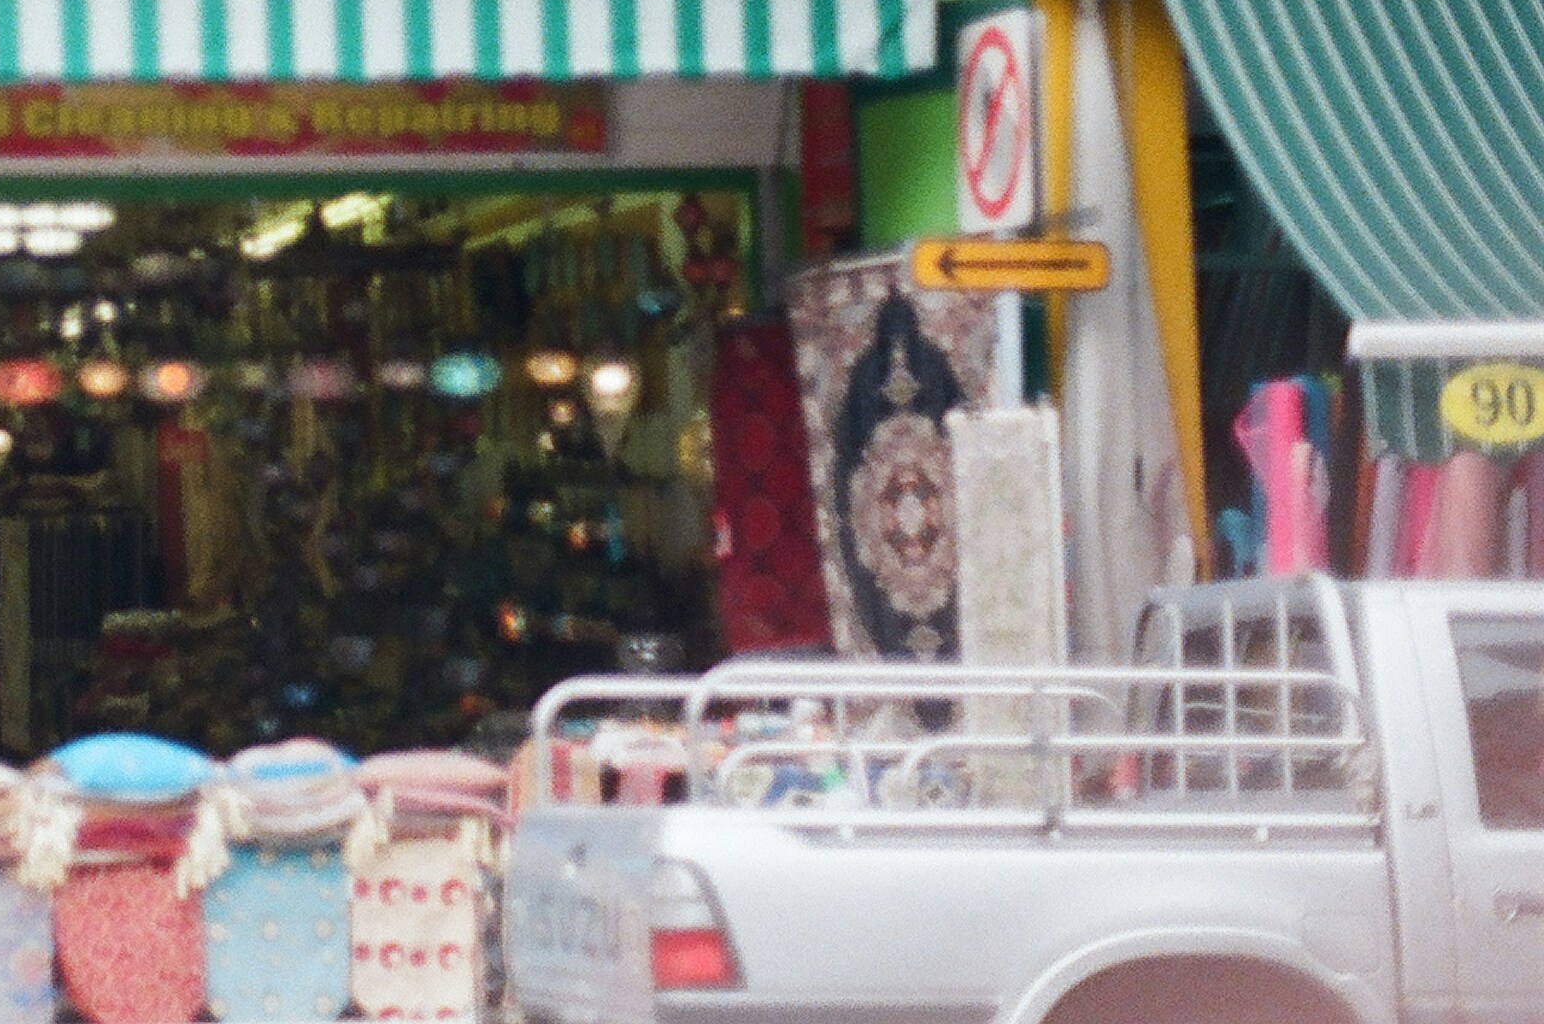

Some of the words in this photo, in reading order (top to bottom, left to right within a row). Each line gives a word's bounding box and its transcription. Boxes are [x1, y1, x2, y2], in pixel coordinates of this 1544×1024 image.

[21, 99, 253, 138] Cleaning
[312, 99, 560, 138] Repairing
[1471, 379, 1536, 427] 90
